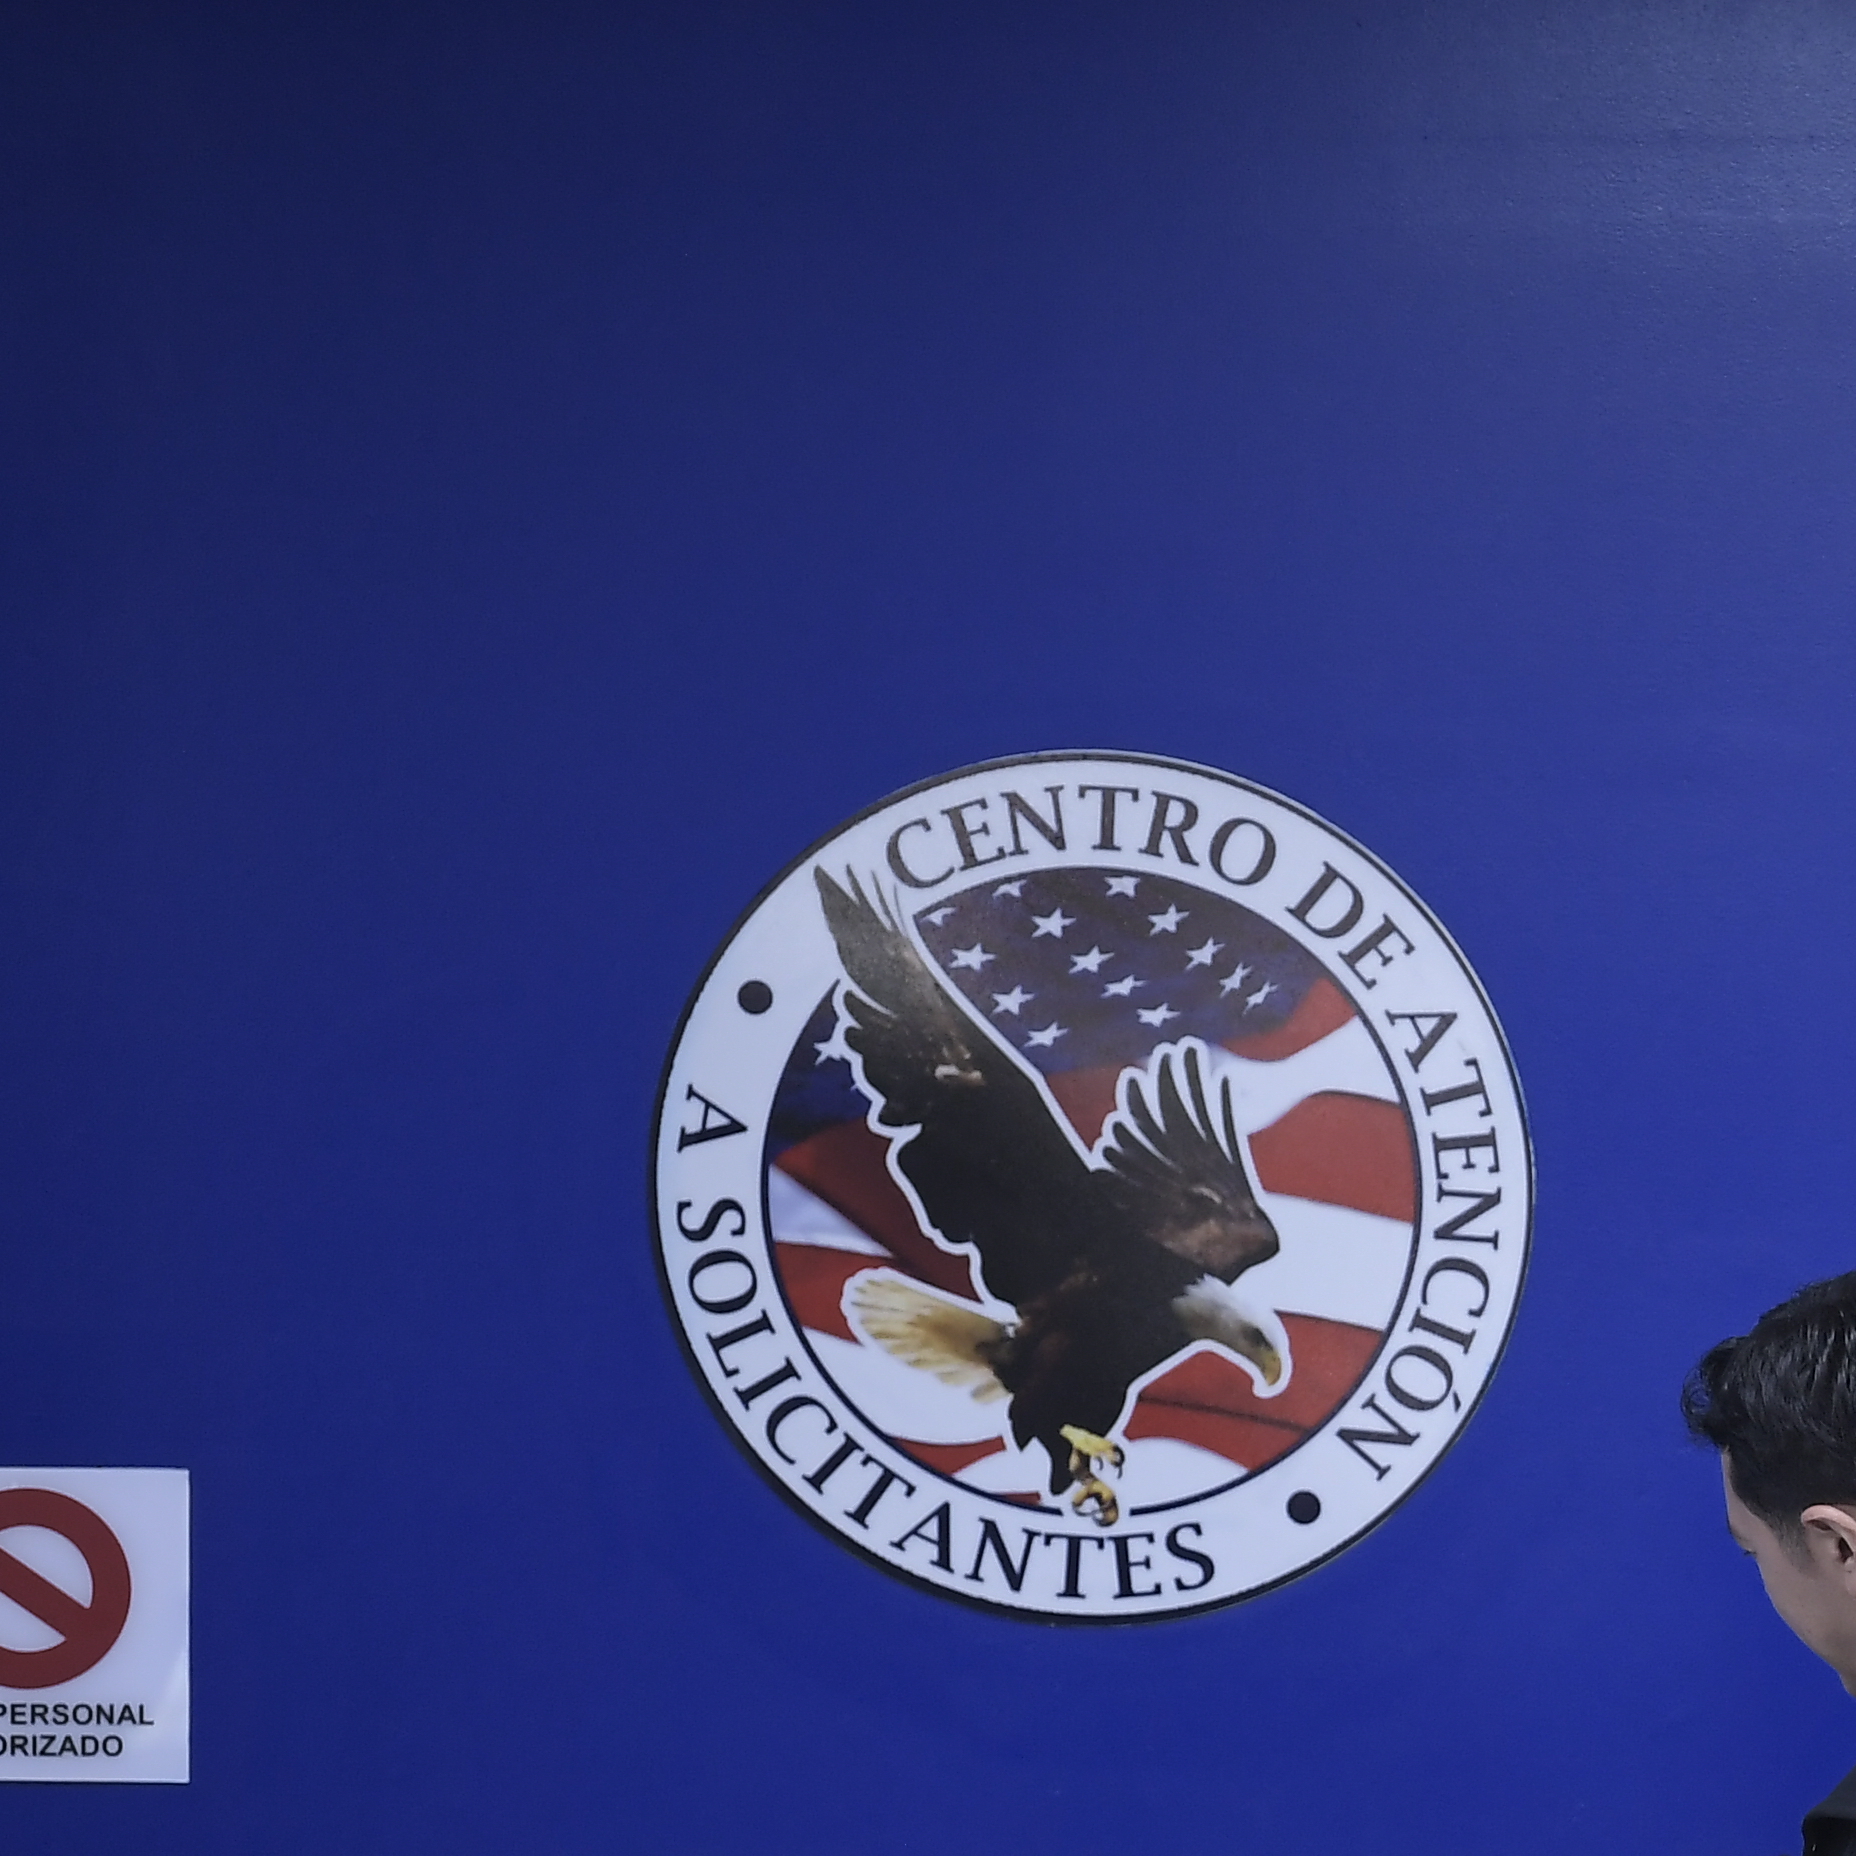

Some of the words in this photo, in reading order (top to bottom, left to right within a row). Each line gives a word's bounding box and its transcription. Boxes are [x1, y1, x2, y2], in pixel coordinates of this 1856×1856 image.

[886, 784, 1277, 890] CENTRO
[1285, 861, 1415, 991] DE
[678, 1083, 749, 1155] A
[1336, 1008, 1504, 1483] ATENCIÓN
[676, 1196, 1217, 1600] SOLICITANTES
